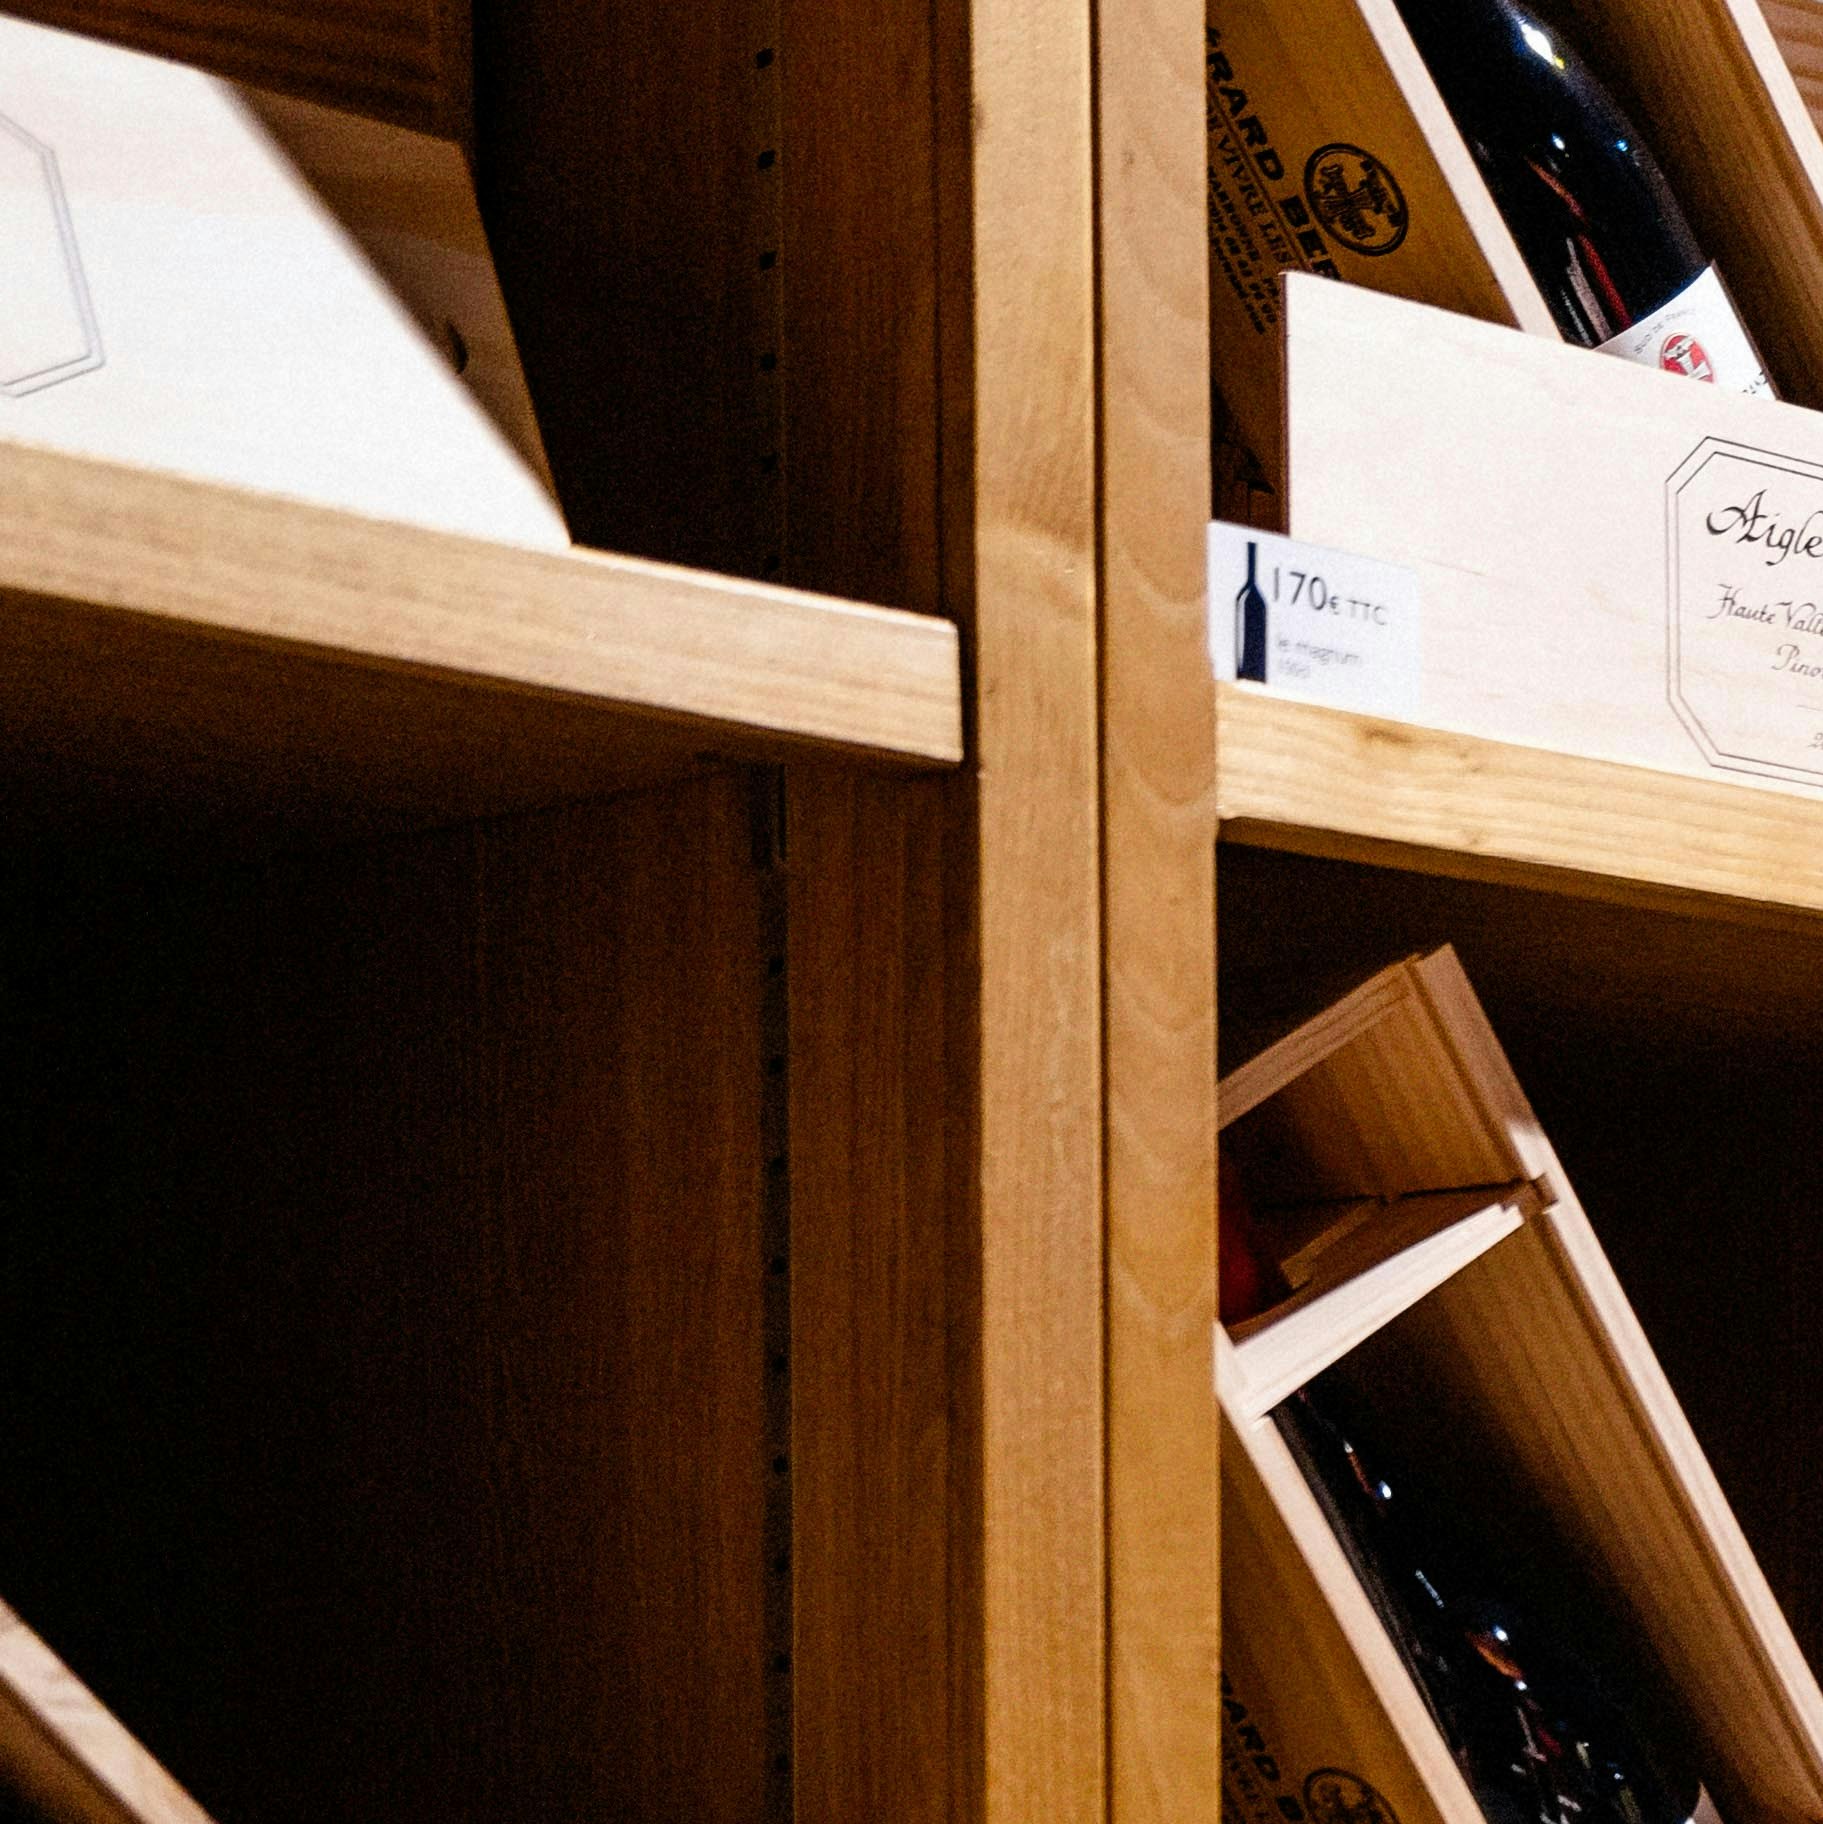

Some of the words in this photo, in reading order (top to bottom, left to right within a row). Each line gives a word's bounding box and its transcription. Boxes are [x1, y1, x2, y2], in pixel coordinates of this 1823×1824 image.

[1273, 566, 1341, 616] 170€
[1345, 598, 1389, 627] TTC
[1706, 582, 1775, 625] Haute
